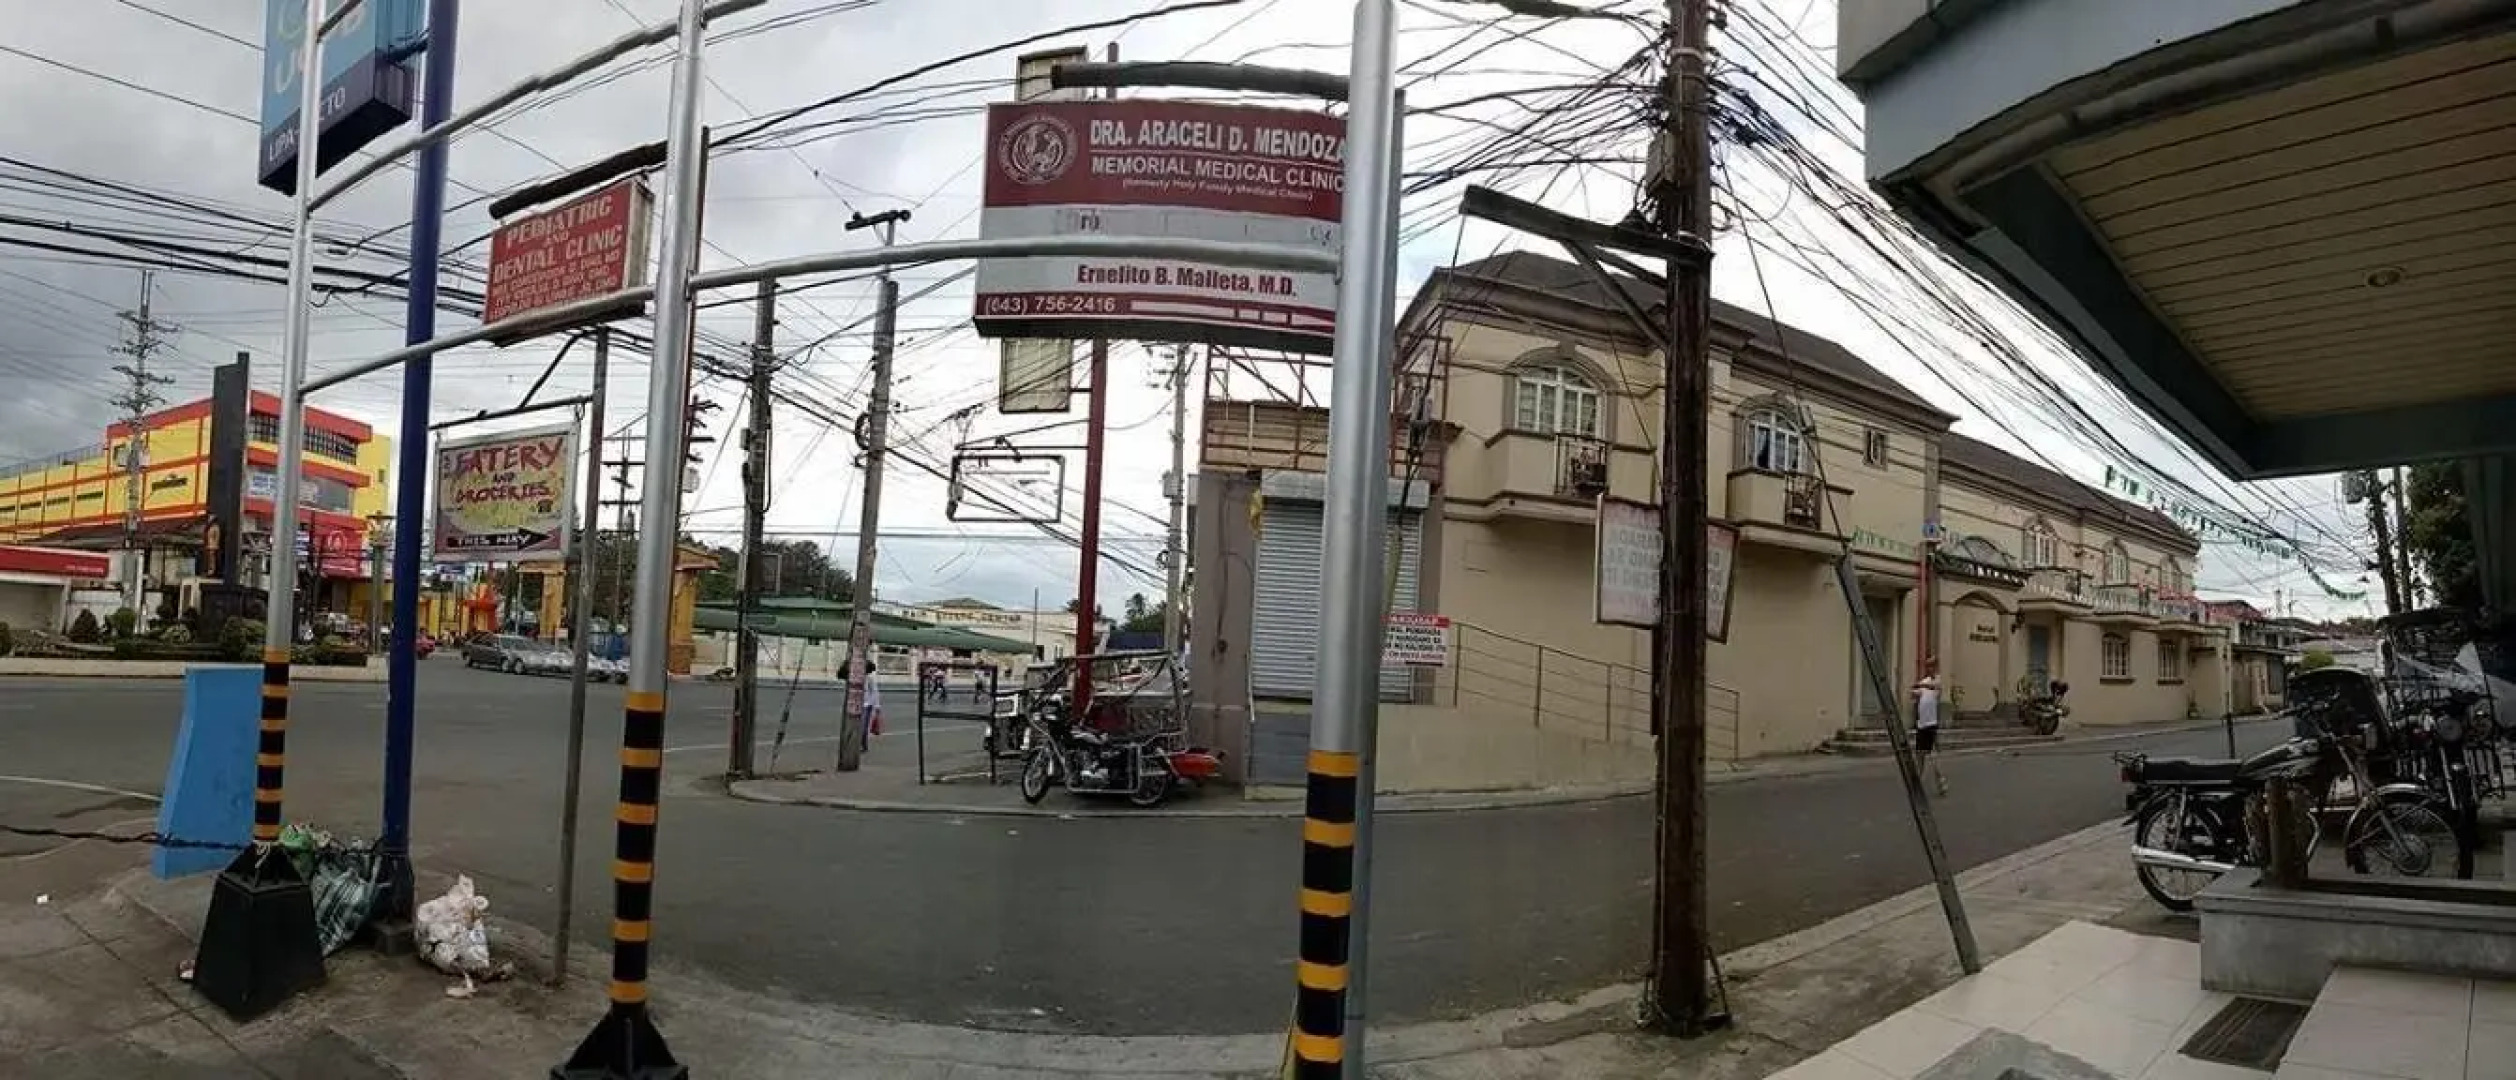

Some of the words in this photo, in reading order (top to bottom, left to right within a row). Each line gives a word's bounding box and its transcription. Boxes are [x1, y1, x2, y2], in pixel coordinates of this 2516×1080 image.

[1090, 119, 1132, 146] DRA.
[1138, 120, 1222, 151] ARACELI
[1229, 126, 1248, 151] D.
[1092, 156, 1190, 176] MEMORIAL
[1195, 160, 1282, 184] MEDICAL
[1285, 168, 1345, 192] CLINIC
[507, 195, 613, 249] PEDIATRIC
[494, 248, 559, 283] DENTAL
[565, 224, 623, 260] CLINIC
[1077, 263, 1150, 285] Ernelito
[1154, 265, 1173, 286] B.
[1258, 274, 1297, 297] M.D.
[1034, 295, 1115, 312] 756-2416
[457, 436, 563, 478] EATERY
[458, 534, 487, 546] THIS
[495, 532, 531, 546] WAY
